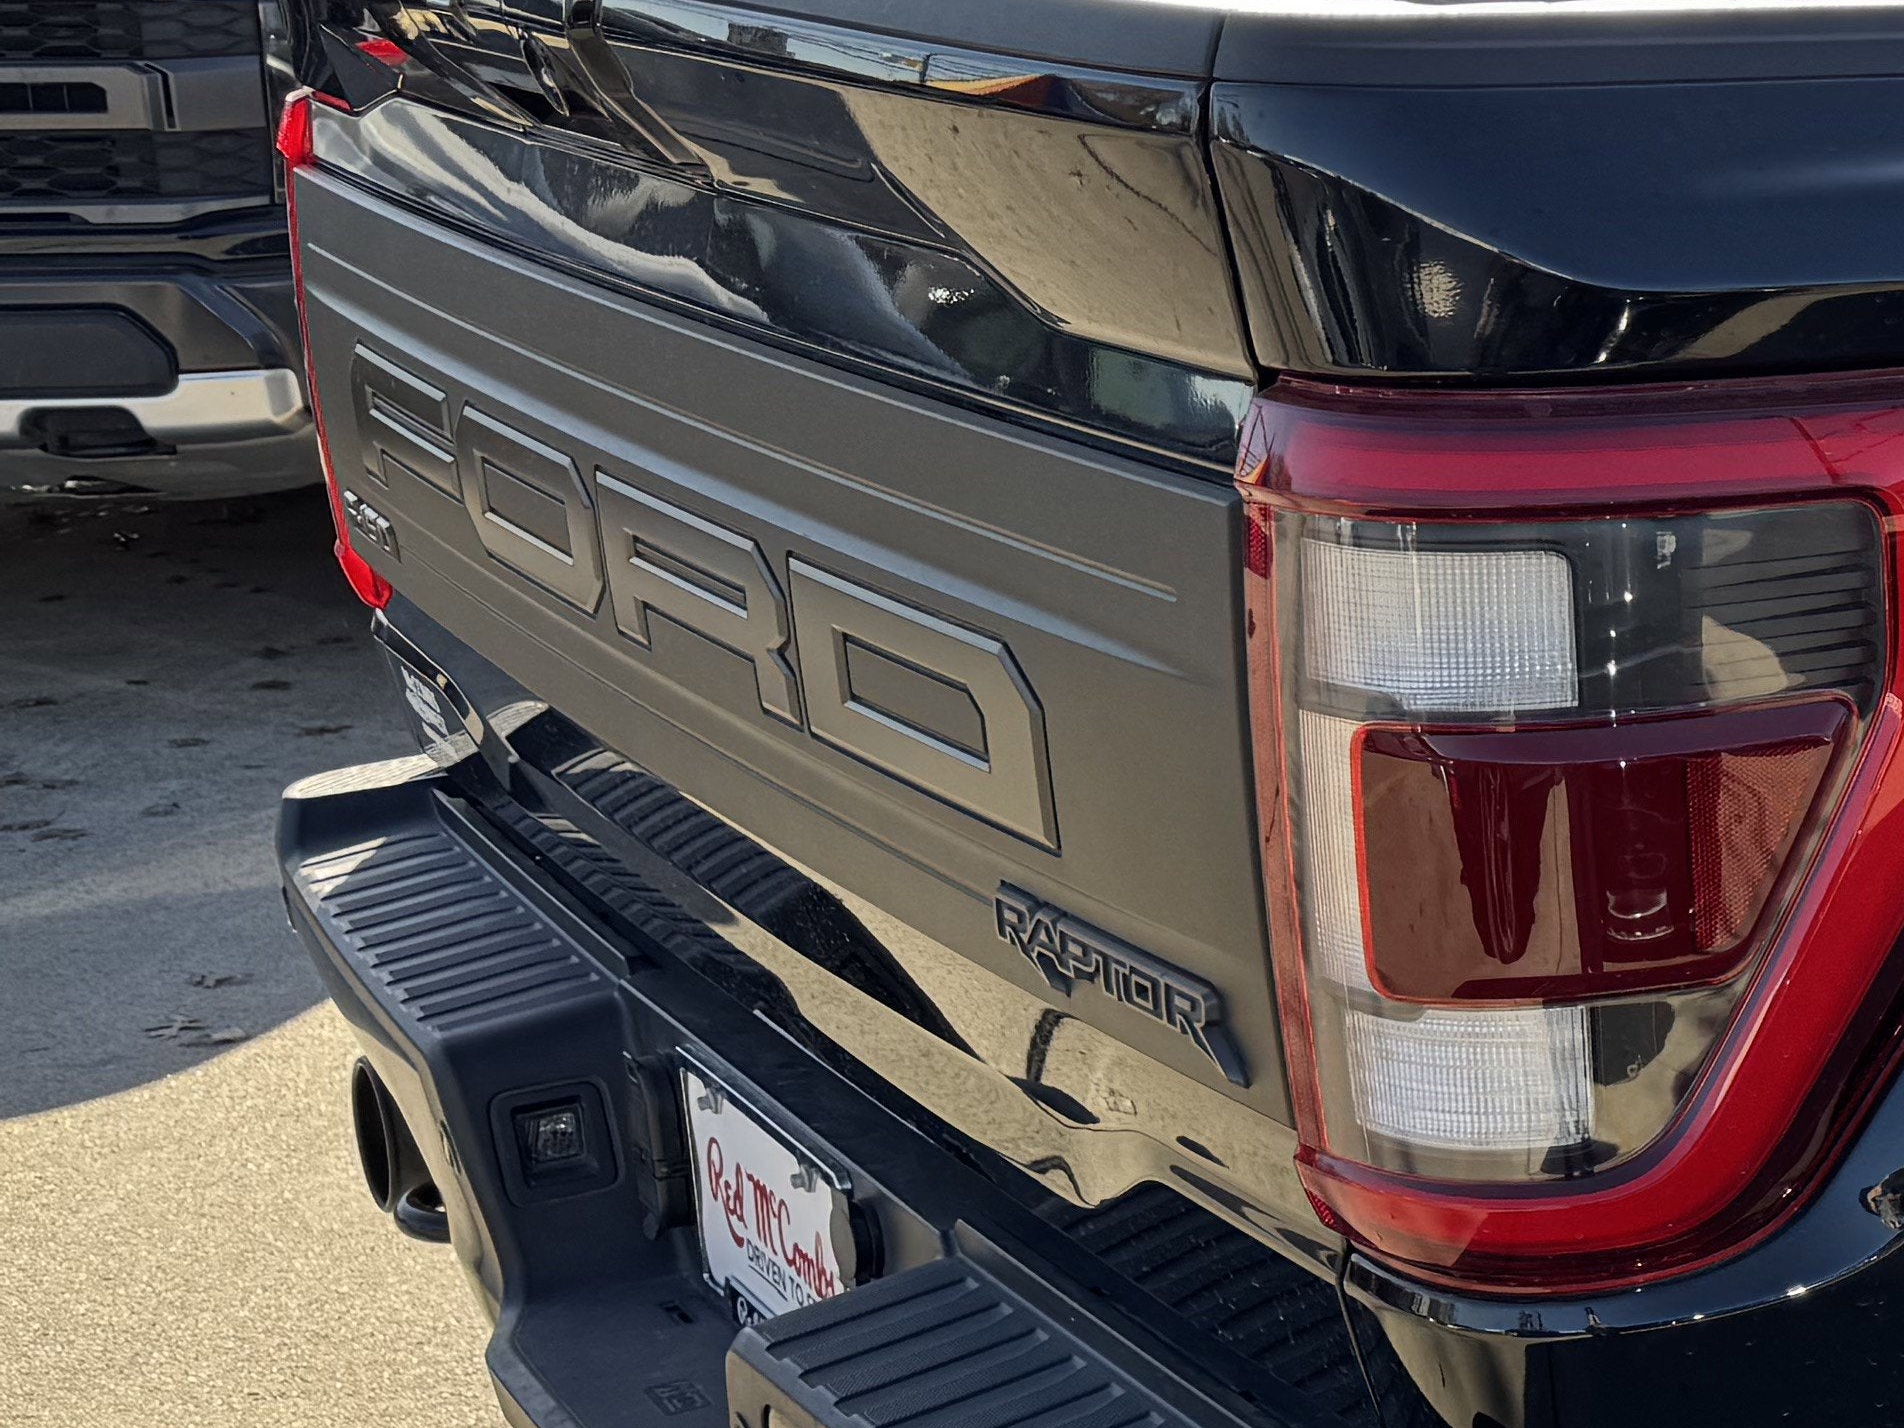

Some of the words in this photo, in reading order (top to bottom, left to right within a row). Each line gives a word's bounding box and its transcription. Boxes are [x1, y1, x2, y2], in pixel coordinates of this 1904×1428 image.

[351, 339, 1062, 857] FORD
[994, 890, 1235, 1082] RAPTOR
[707, 1137, 748, 1248] Red
[747, 1237, 787, 1292] DRIVEN
[788, 1275, 804, 1308] TO
